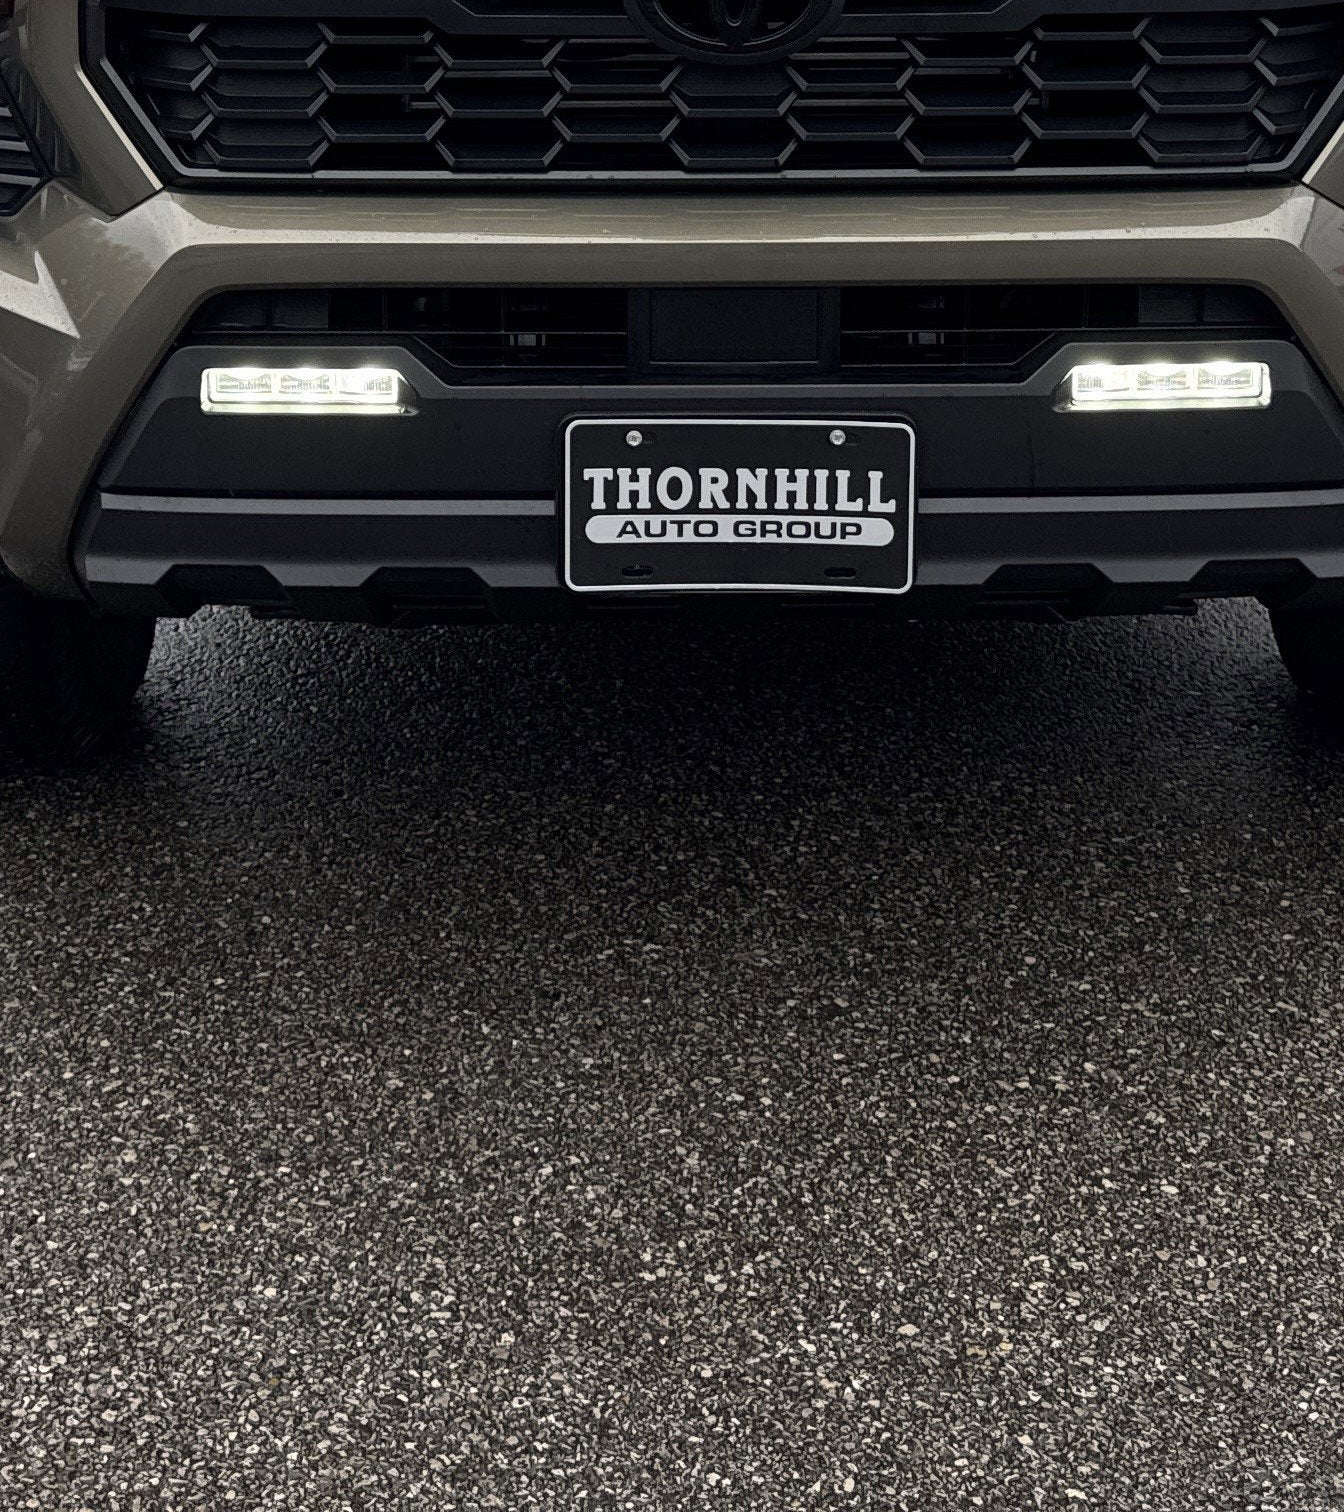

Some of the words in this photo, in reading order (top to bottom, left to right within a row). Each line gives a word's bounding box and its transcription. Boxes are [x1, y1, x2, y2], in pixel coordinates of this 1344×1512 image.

[583, 466, 897, 514] THORNHILL
[616, 519, 720, 538] AUTO
[732, 520, 863, 540] GROUP
